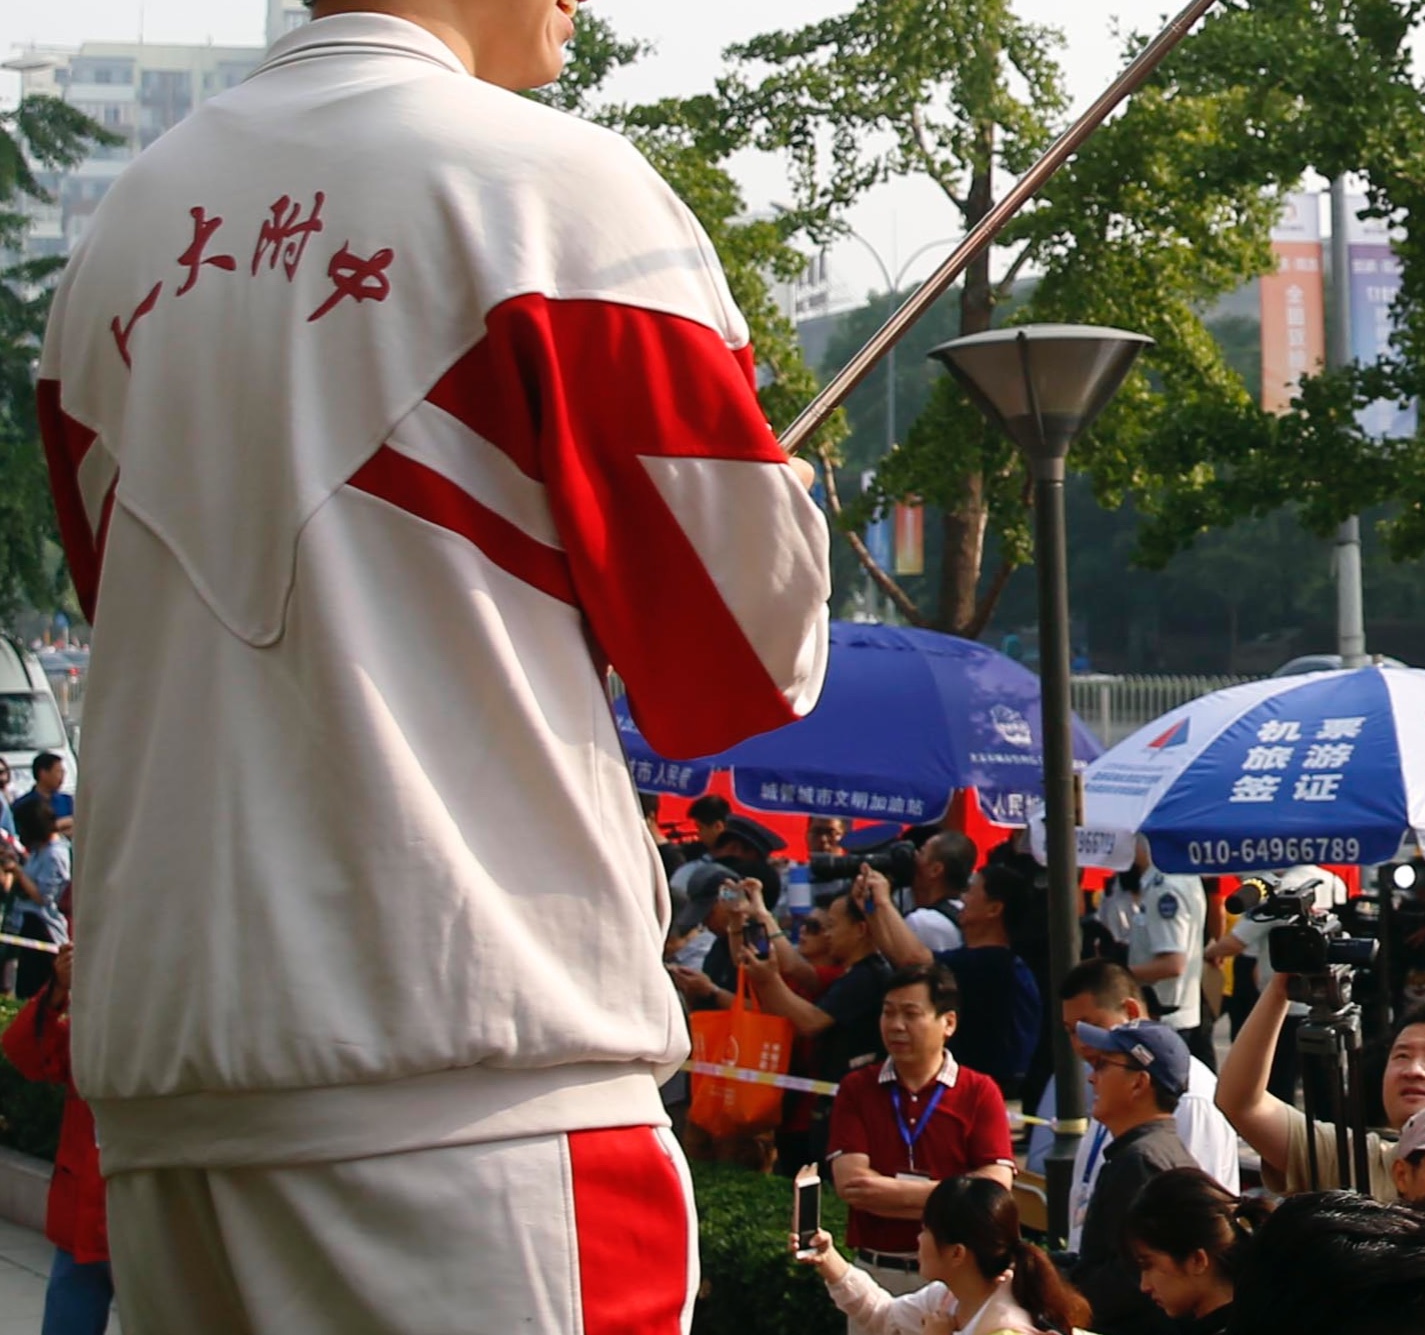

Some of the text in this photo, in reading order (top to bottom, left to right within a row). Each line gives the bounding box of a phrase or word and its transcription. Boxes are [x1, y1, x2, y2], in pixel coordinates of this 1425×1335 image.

[1257, 717, 1367, 742] 机票
[1242, 744, 1355, 770] 旅游
[1229, 774, 1343, 803] 签证
[1188, 837, 1361, 865] 010-64966789
